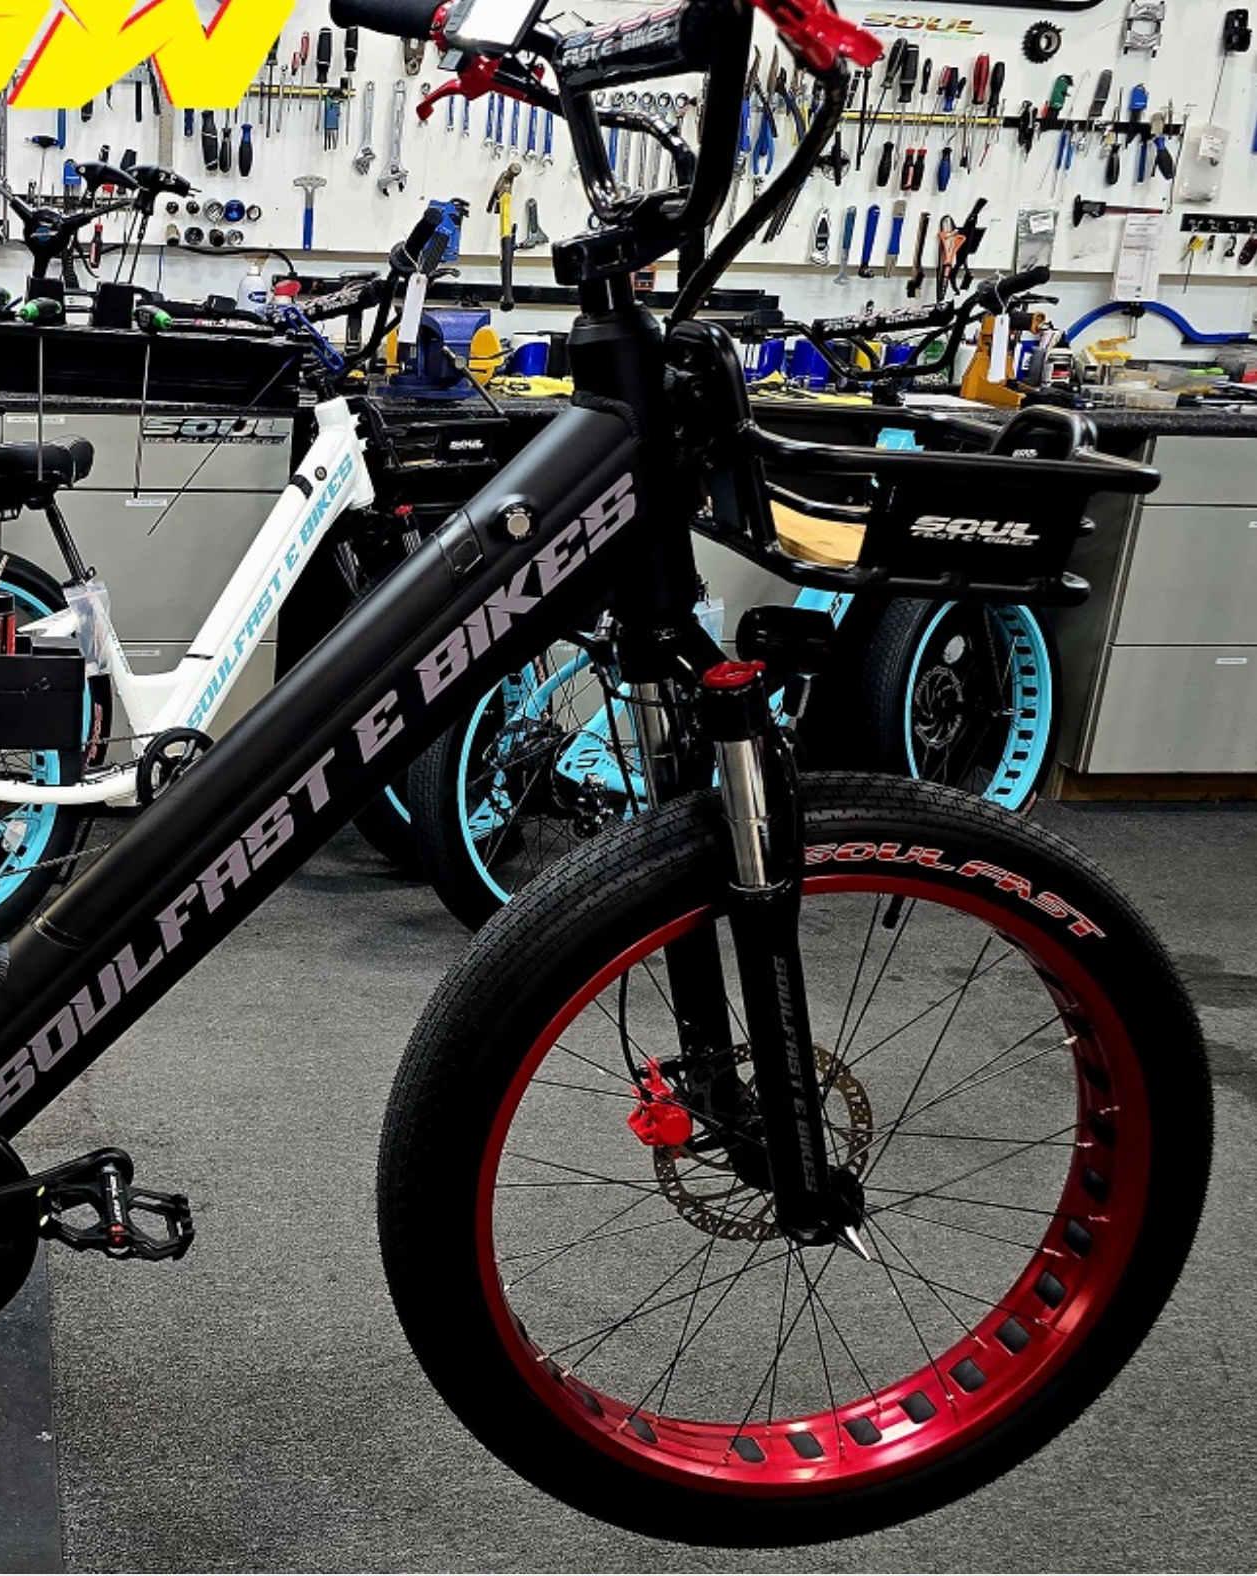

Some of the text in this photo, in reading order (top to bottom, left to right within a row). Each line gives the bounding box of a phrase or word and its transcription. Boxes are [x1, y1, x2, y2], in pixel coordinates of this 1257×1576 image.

[862, 12, 985, 35] SOUL
[142, 416, 290, 437] SOUL
[284, 542, 301, 574] E
[299, 450, 355, 547] BIKES
[909, 515, 1040, 540] SOUL
[349, 690, 406, 765] E
[414, 472, 637, 704] BIKES
